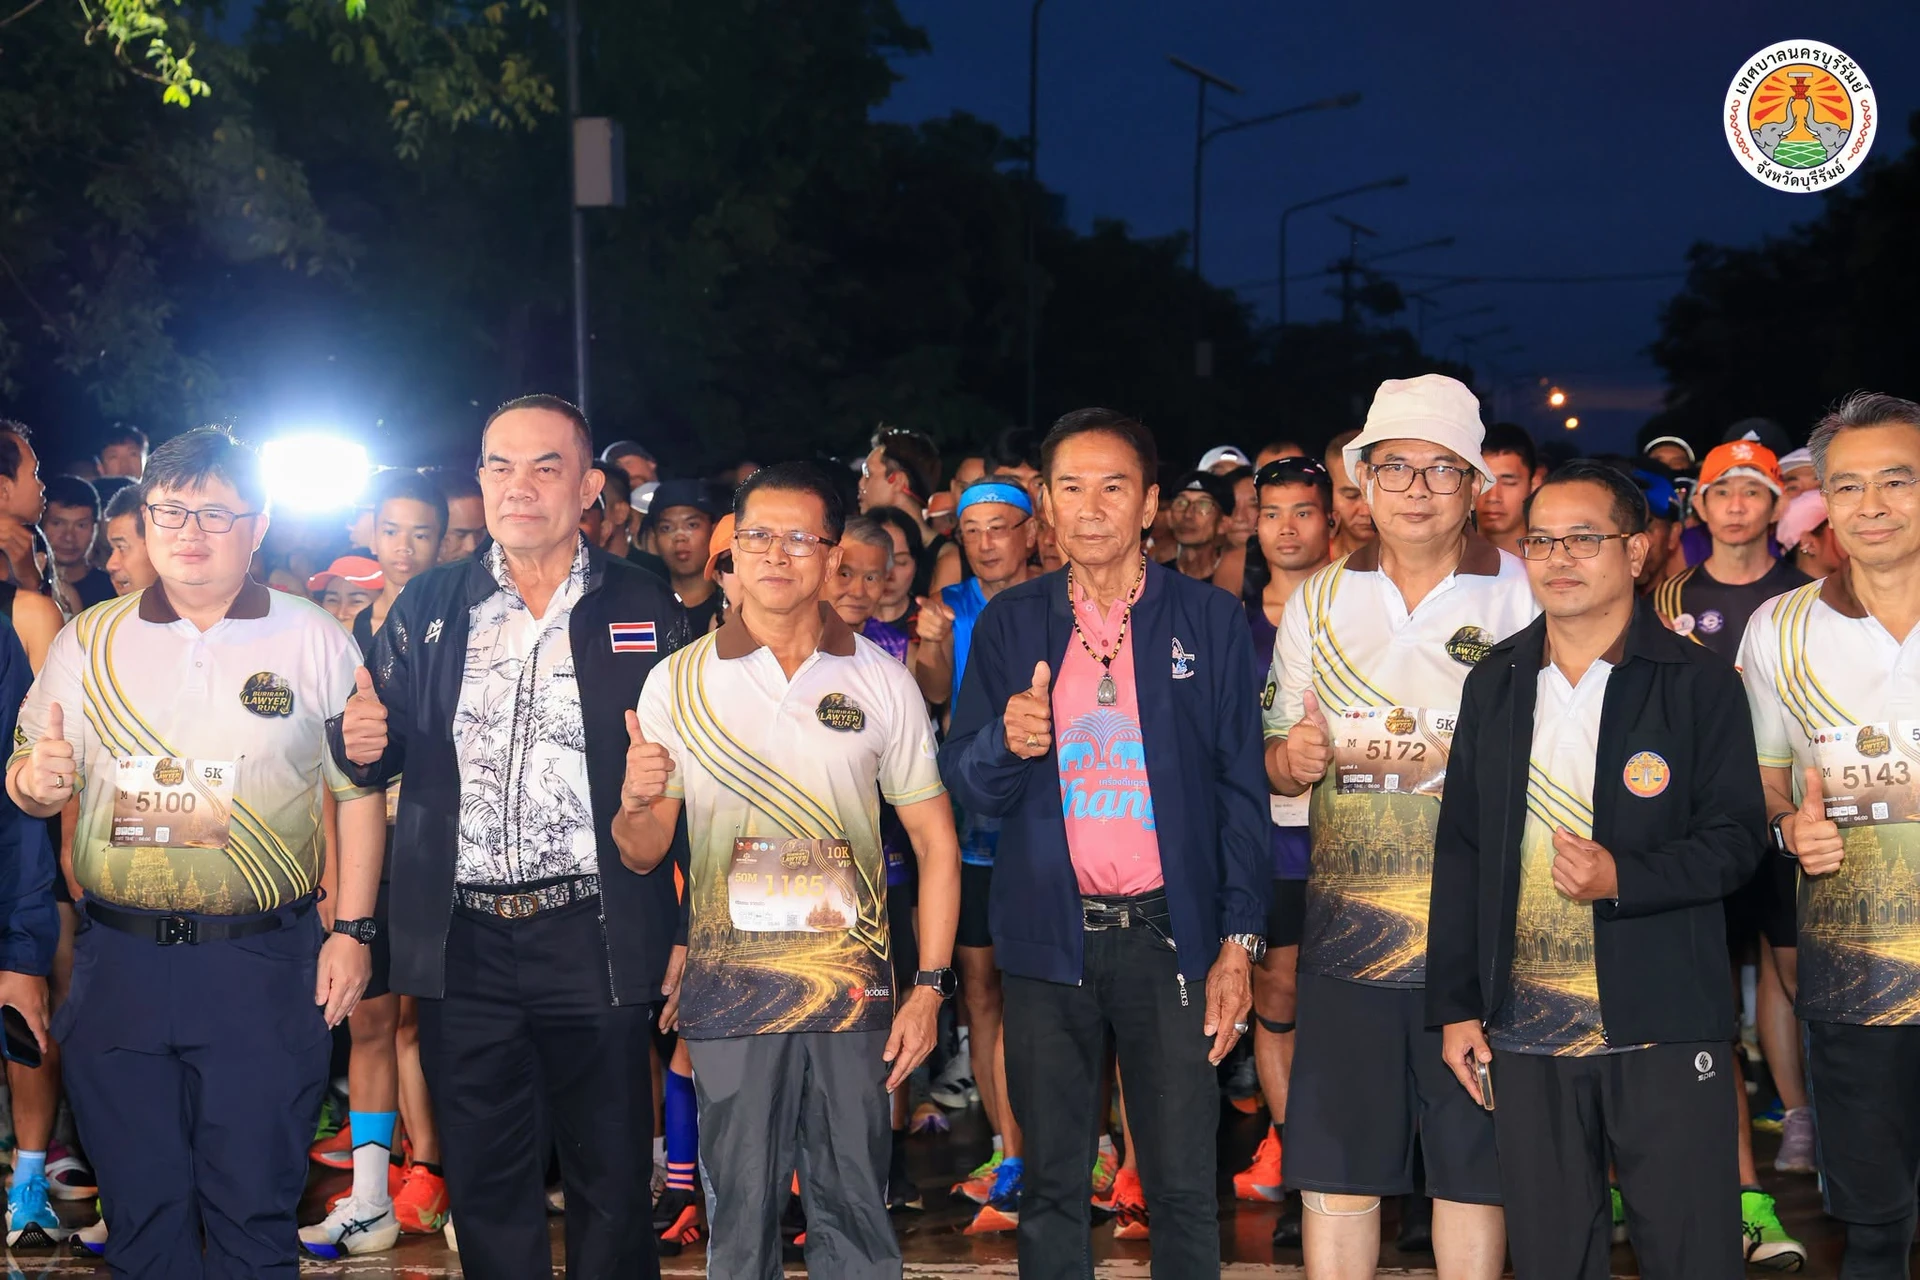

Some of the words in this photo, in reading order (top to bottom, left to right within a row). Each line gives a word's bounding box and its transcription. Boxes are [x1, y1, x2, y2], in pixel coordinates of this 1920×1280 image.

[243, 695, 288, 706] LAWYER
[256, 704, 278, 712] RUN
[820, 712, 860, 722] LAWYER
[1435, 718, 1455, 731] 5K
[1347, 738, 1357, 748] M
[1365, 739, 1427, 762] 5172
[203, 767, 224, 779] 5K
[1822, 767, 1832, 778] M
[1843, 761, 1911, 789] 5143
[120, 790, 128, 800] M
[135, 791, 195, 813] 5100
[827, 846, 850, 859] 10K
[837, 860, 852, 868] VIP
[735, 872, 758, 884] 50M
[765, 874, 826, 898] 1185
